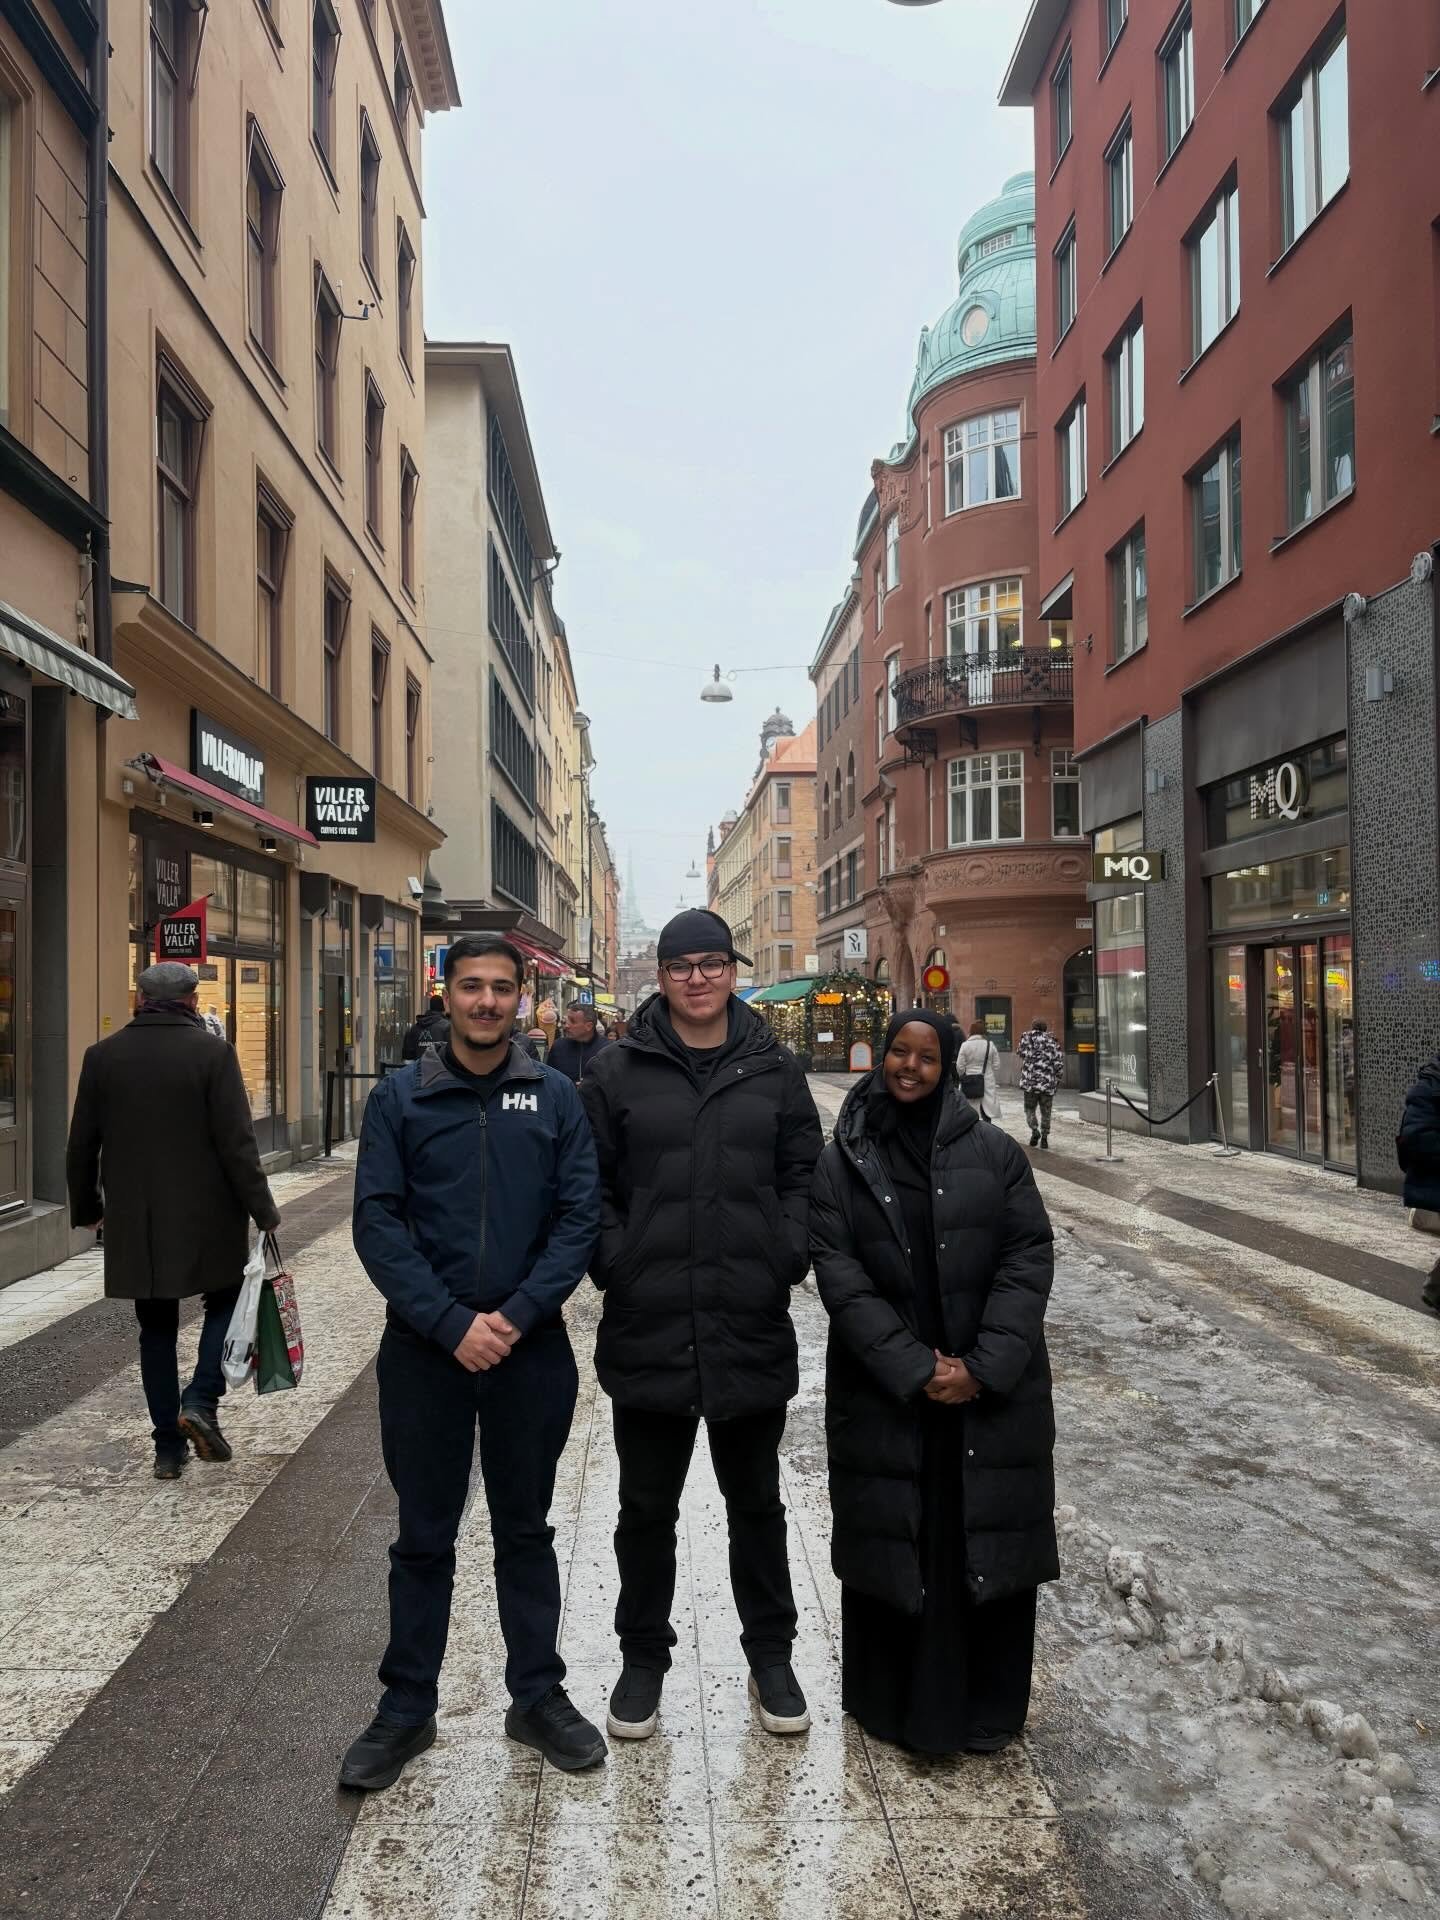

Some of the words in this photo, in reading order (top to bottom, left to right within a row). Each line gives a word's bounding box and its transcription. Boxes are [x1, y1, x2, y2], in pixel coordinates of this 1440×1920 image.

[315, 786, 366, 805] VILLER
[1249, 762, 1300, 820] MQ
[156, 858, 179, 884] VILLER
[1104, 856, 1152, 881] MQ
[164, 923, 197, 935] VILLER
[502, 1092, 538, 1112] HH
